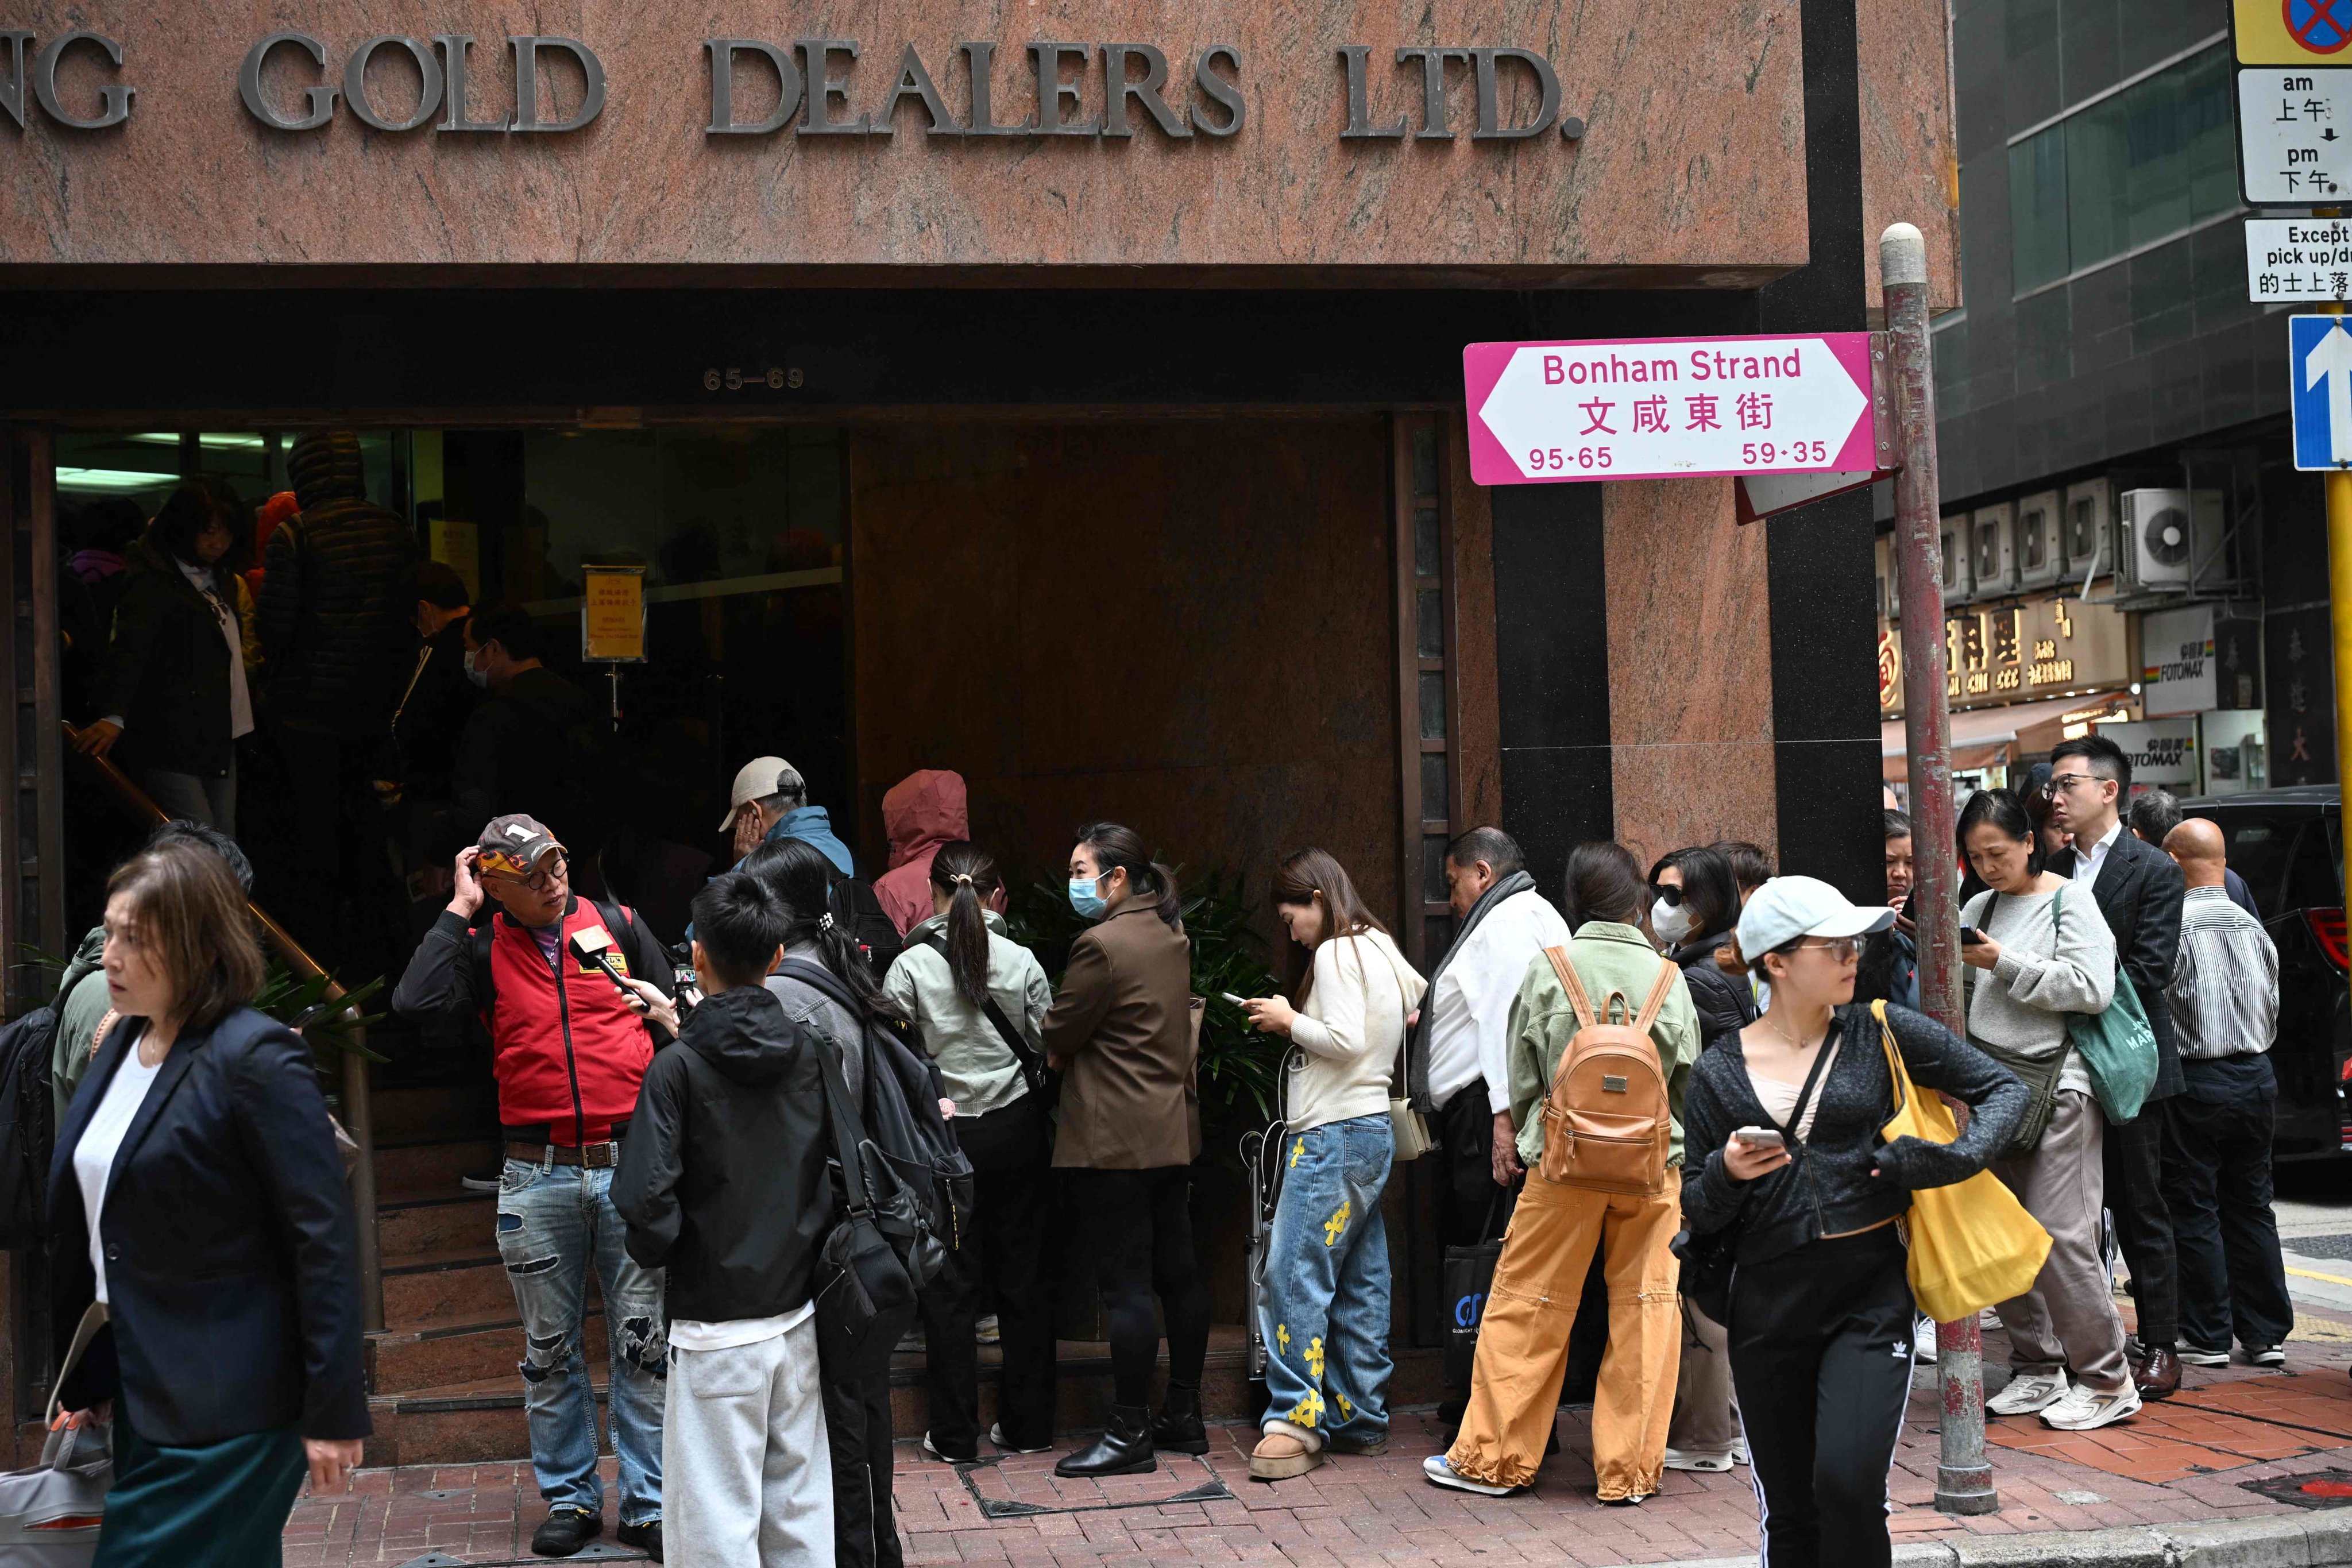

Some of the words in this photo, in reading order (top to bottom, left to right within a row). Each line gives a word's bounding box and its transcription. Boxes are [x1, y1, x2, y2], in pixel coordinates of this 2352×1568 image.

[240, 33, 606, 132] GOLD
[704, 39, 1246, 137] DEALERS
[1338, 45, 1586, 141] LTD.
[2283, 77, 2313, 91] am
[2276, 98, 2325, 122] 上午
[2288, 148, 2318, 167] pm
[2279, 169, 2330, 194] 下午
[2288, 226, 2350, 246] Except
[2268, 248, 2304, 267] pick
[2309, 247, 2352, 266] up/d
[2259, 272, 2349, 294] 的士上落
[1543, 353, 1678, 385] Bonham
[1690, 347, 1801, 380] Strand
[1578, 392, 1774, 436] 文咸東街
[2161, 660, 2204, 683] FOTOMAX
[504, 823, 543, 843] 1
